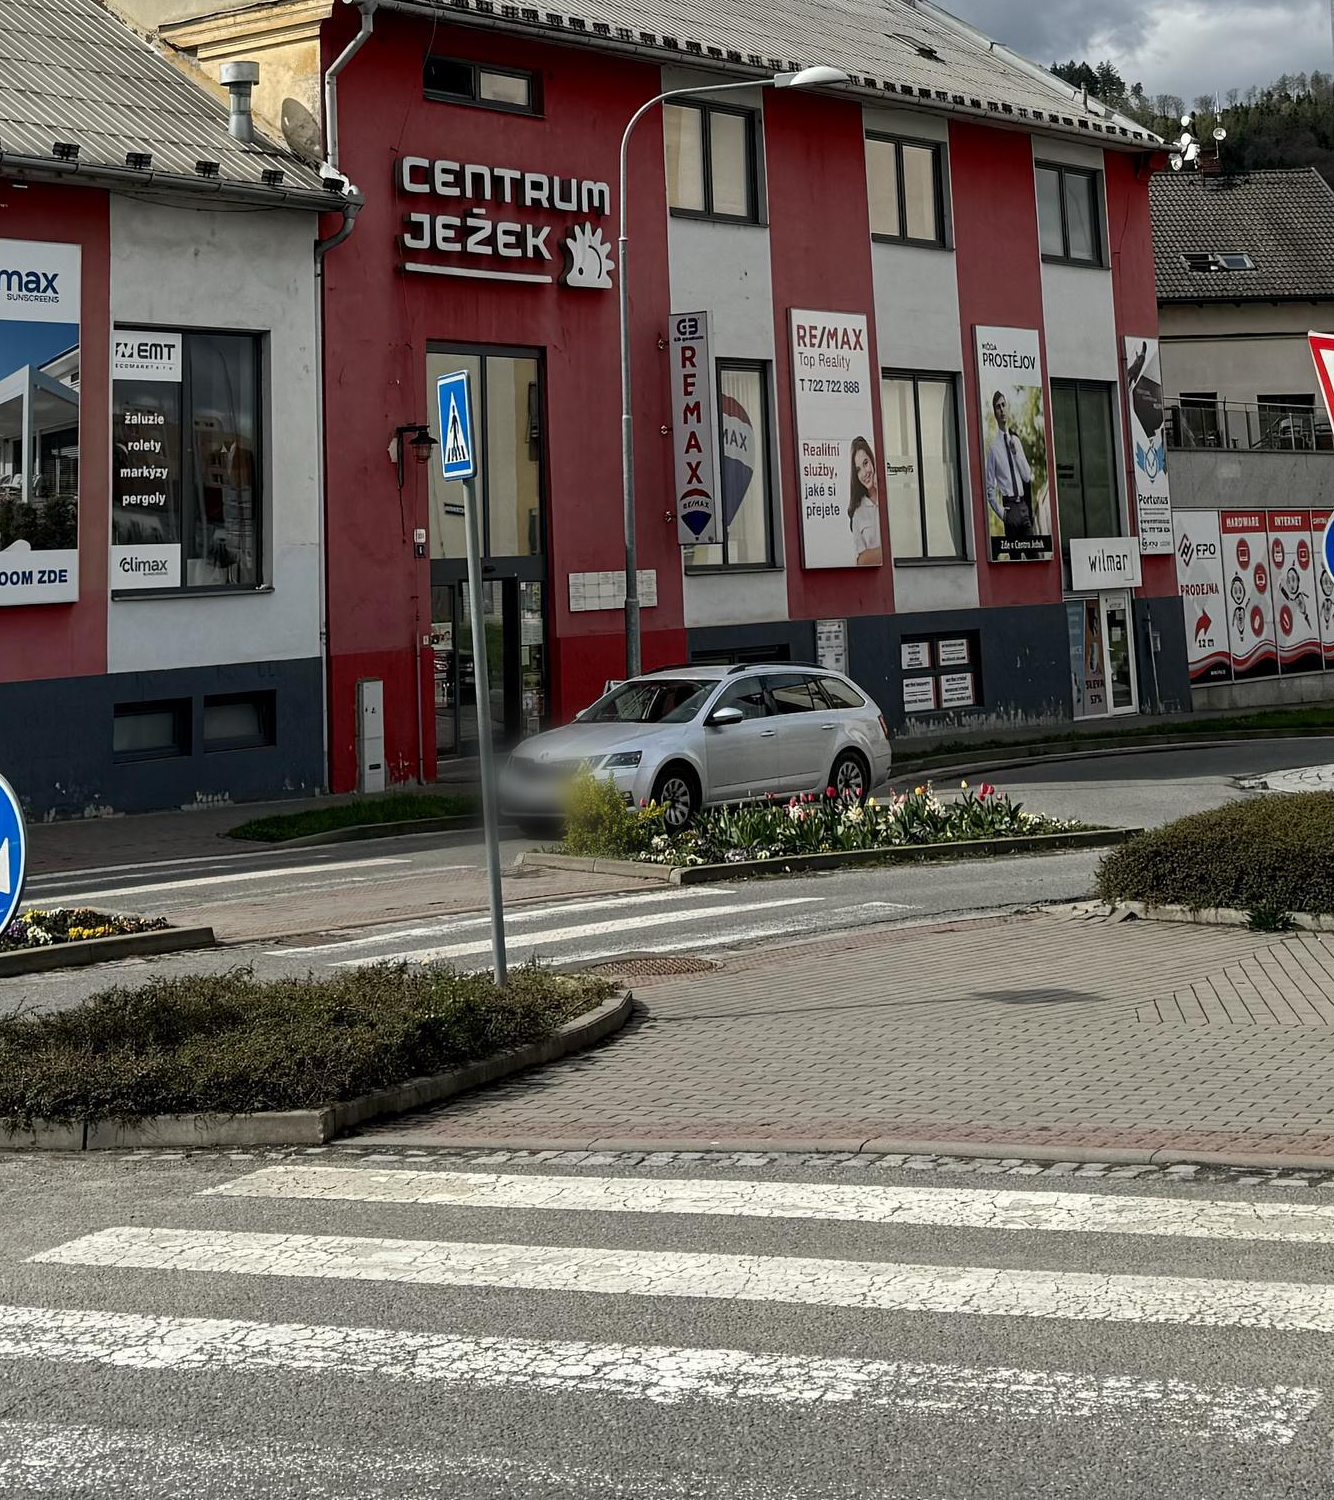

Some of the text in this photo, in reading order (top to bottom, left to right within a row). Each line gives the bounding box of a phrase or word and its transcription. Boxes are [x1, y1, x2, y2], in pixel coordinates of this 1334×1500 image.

[402, 156, 610, 216] CENTRUM
[404, 208, 553, 260] JEŽEK
[7, 293, 59, 303] SUNSCREENS
[797, 324, 864, 351] RE/MAX
[138, 343, 175, 360] EMT
[798, 352, 850, 371] Top Reality
[799, 379, 859, 393] T 722 722 888
[125, 413, 164, 424] žaluzie
[680, 346, 702, 485] REMAX
[128, 439, 161, 452] rolety
[803, 443, 840, 456] Realitní
[120, 466, 168, 478] markýzy
[804, 463, 837, 479] služby,
[805, 483, 836, 499] jaké si
[122, 493, 166, 506] pergoly
[807, 502, 840, 519] přejete
[1227, 516, 1259, 527] HARDWARE
[1274, 516, 1302, 526] INTERNET
[1196, 544, 1216, 556] FPO
[119, 557, 168, 573] climax
[1089, 548, 1127, 572] wilmar
[38, 569, 68, 583] ZDE
[1180, 583, 1219, 596] PRODEJNA
[1199, 639, 1206, 648] 12
